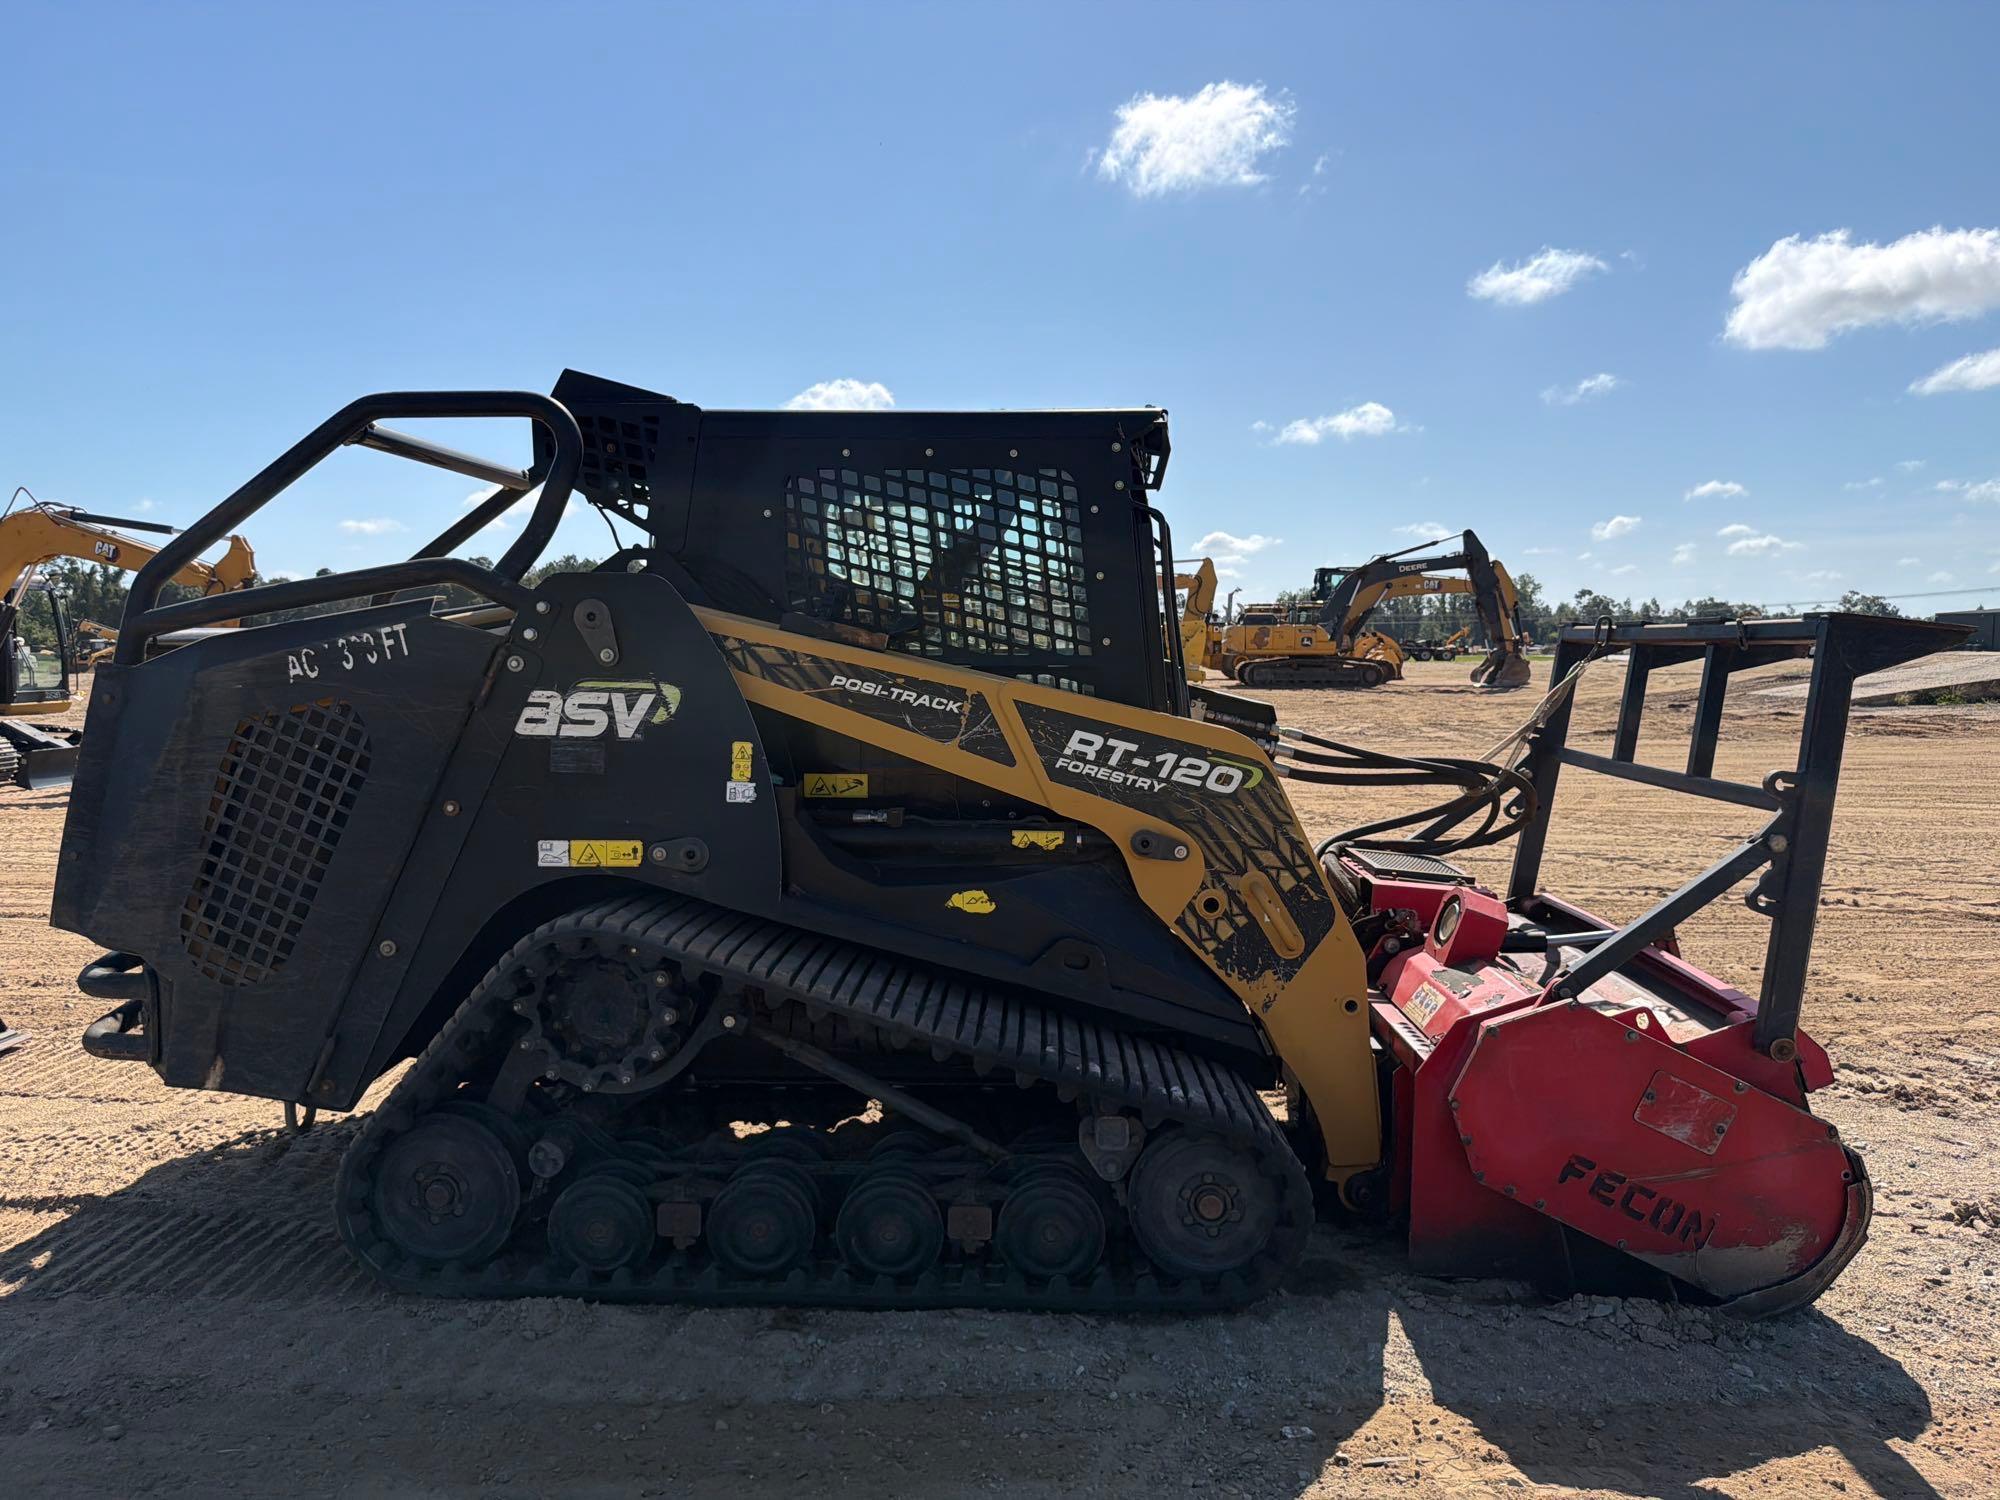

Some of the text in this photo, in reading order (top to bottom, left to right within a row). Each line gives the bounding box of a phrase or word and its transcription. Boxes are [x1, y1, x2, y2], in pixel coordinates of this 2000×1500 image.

[95, 541, 116, 558] CAT
[1399, 563, 1428, 573] DEERE
[1424, 579, 1440, 590] CAT
[830, 674, 963, 714] POSI-TRACK
[1055, 757, 1167, 793] FORESTRY
[1063, 729, 1243, 794] RT-120
[1558, 1153, 1716, 1251] FECON
